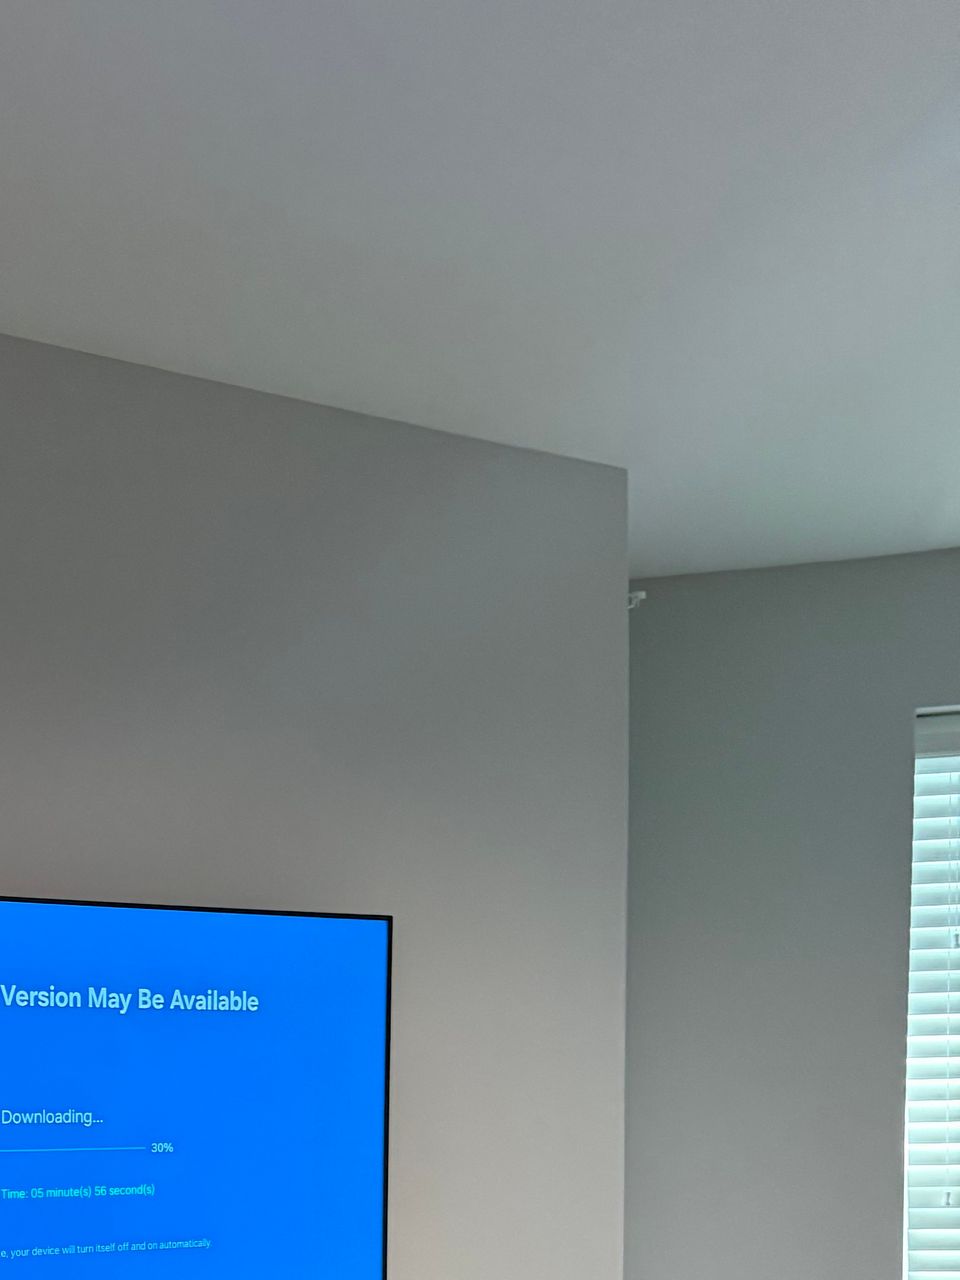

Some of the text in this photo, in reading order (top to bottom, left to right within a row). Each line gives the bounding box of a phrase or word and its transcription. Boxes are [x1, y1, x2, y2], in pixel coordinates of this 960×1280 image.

[0, 985, 81, 1008] Version
[88, 987, 132, 1014] May
[138, 989, 164, 1010] Be
[170, 989, 259, 1011] Available
[1, 1109, 103, 1127] Downloading...
[151, 1142, 174, 1153] 30%
[1, 1188, 29, 1200] Time:
[31, 1187, 44, 1199] 05
[46, 1186, 91, 1199] minute(s)
[94, 1186, 107, 1197] 56
[109, 1184, 155, 1197] second(s)
[10, 1248, 30, 1260] your
[31, 1245, 60, 1257] device
[62, 1244, 76, 1255] will
[77, 1244, 94, 1254] turn
[95, 1242, 116, 1253] itself
[117, 1241, 129, 1252] off
[130, 1239, 146, 1251] and
[147, 1241, 158, 1250] on
